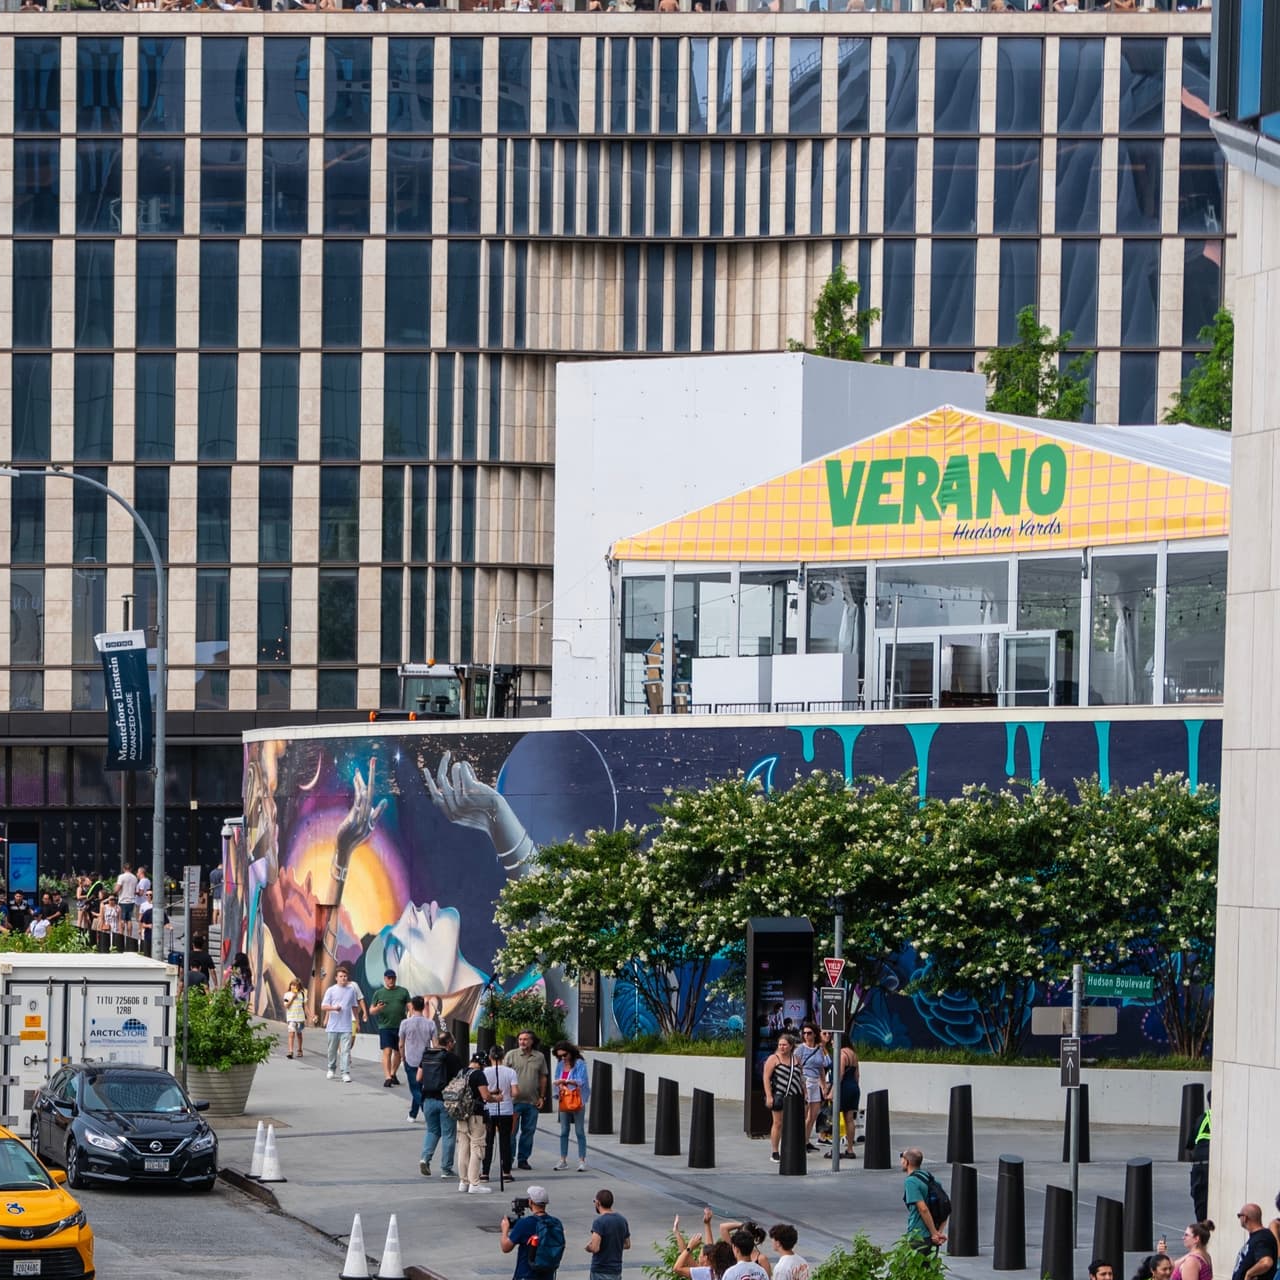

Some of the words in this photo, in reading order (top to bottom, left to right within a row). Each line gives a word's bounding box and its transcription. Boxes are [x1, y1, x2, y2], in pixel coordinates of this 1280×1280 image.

[825, 443, 1067, 527] VERANO
[952, 523, 1012, 541] Hudson
[1018, 516, 1063, 538] Yards
[109, 656, 124, 700] Einstein
[125, 691, 134, 715] CARE
[115, 702, 128, 761] Montefiore
[127, 716, 137, 761] ADVANCED
[1087, 976, 1114, 987] Hudson
[1115, 977, 1151, 989] Boulevard
[96, 996, 113, 1004] TITU
[116, 996, 140, 1005] 725606
[90, 1028, 148, 1037] ARCTICSTORE
